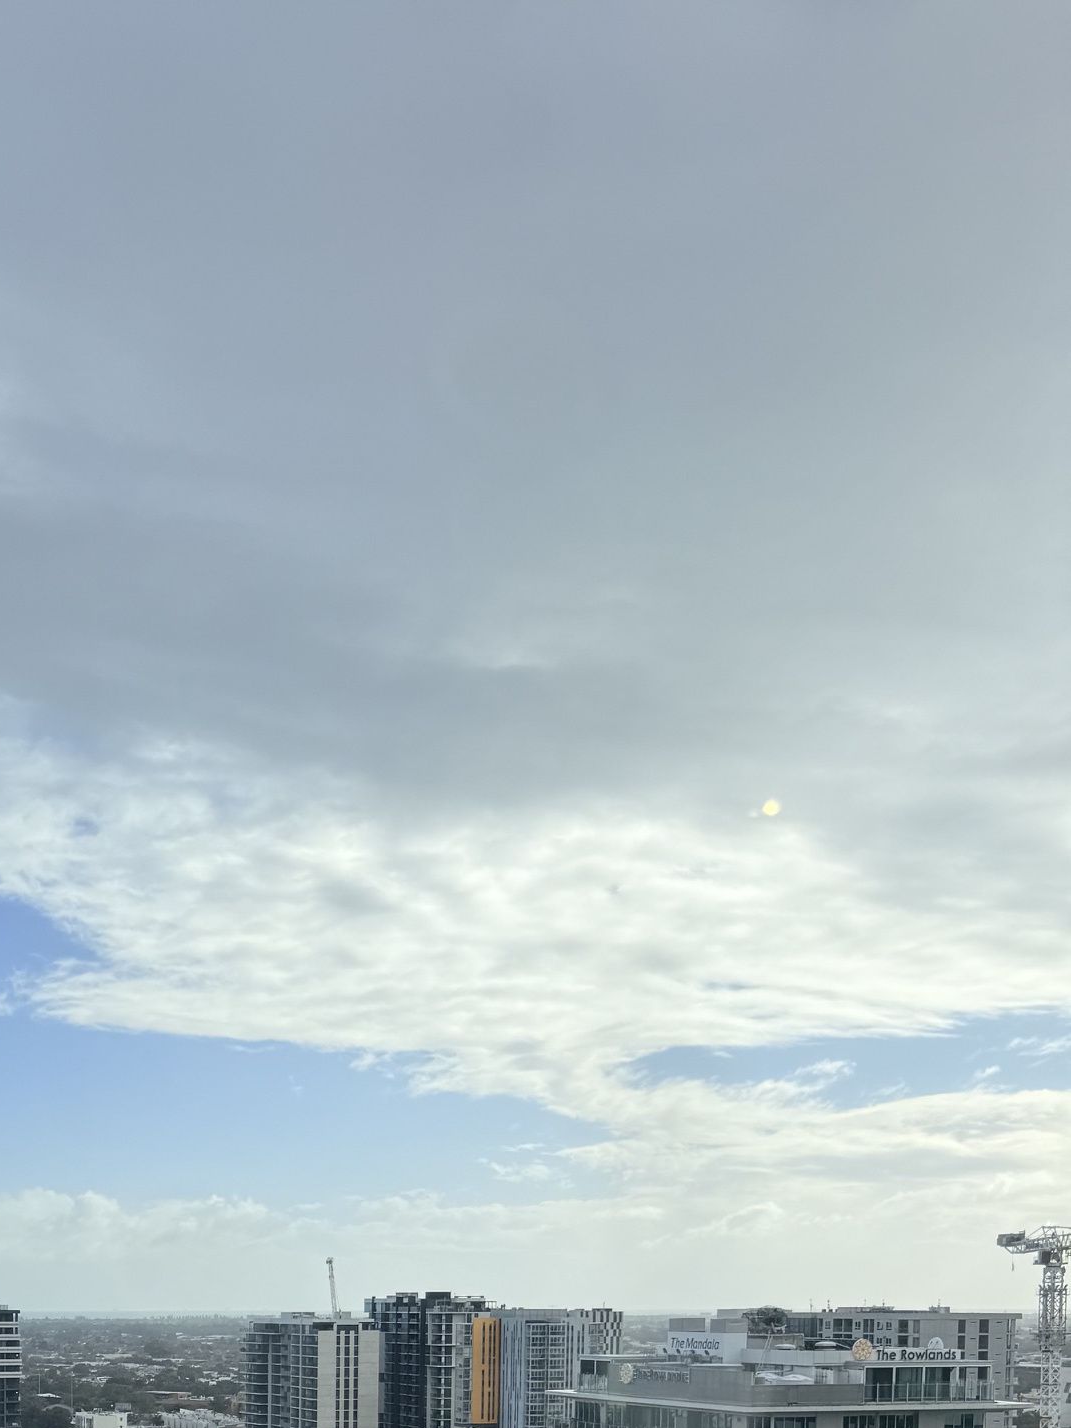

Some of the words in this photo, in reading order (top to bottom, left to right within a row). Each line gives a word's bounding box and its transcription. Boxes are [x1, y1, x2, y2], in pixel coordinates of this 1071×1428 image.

[671, 1337, 685, 1348] The
[686, 1338, 720, 1350] Mandala
[877, 1350, 896, 1360] The
[901, 1349, 957, 1360] Rowlands
